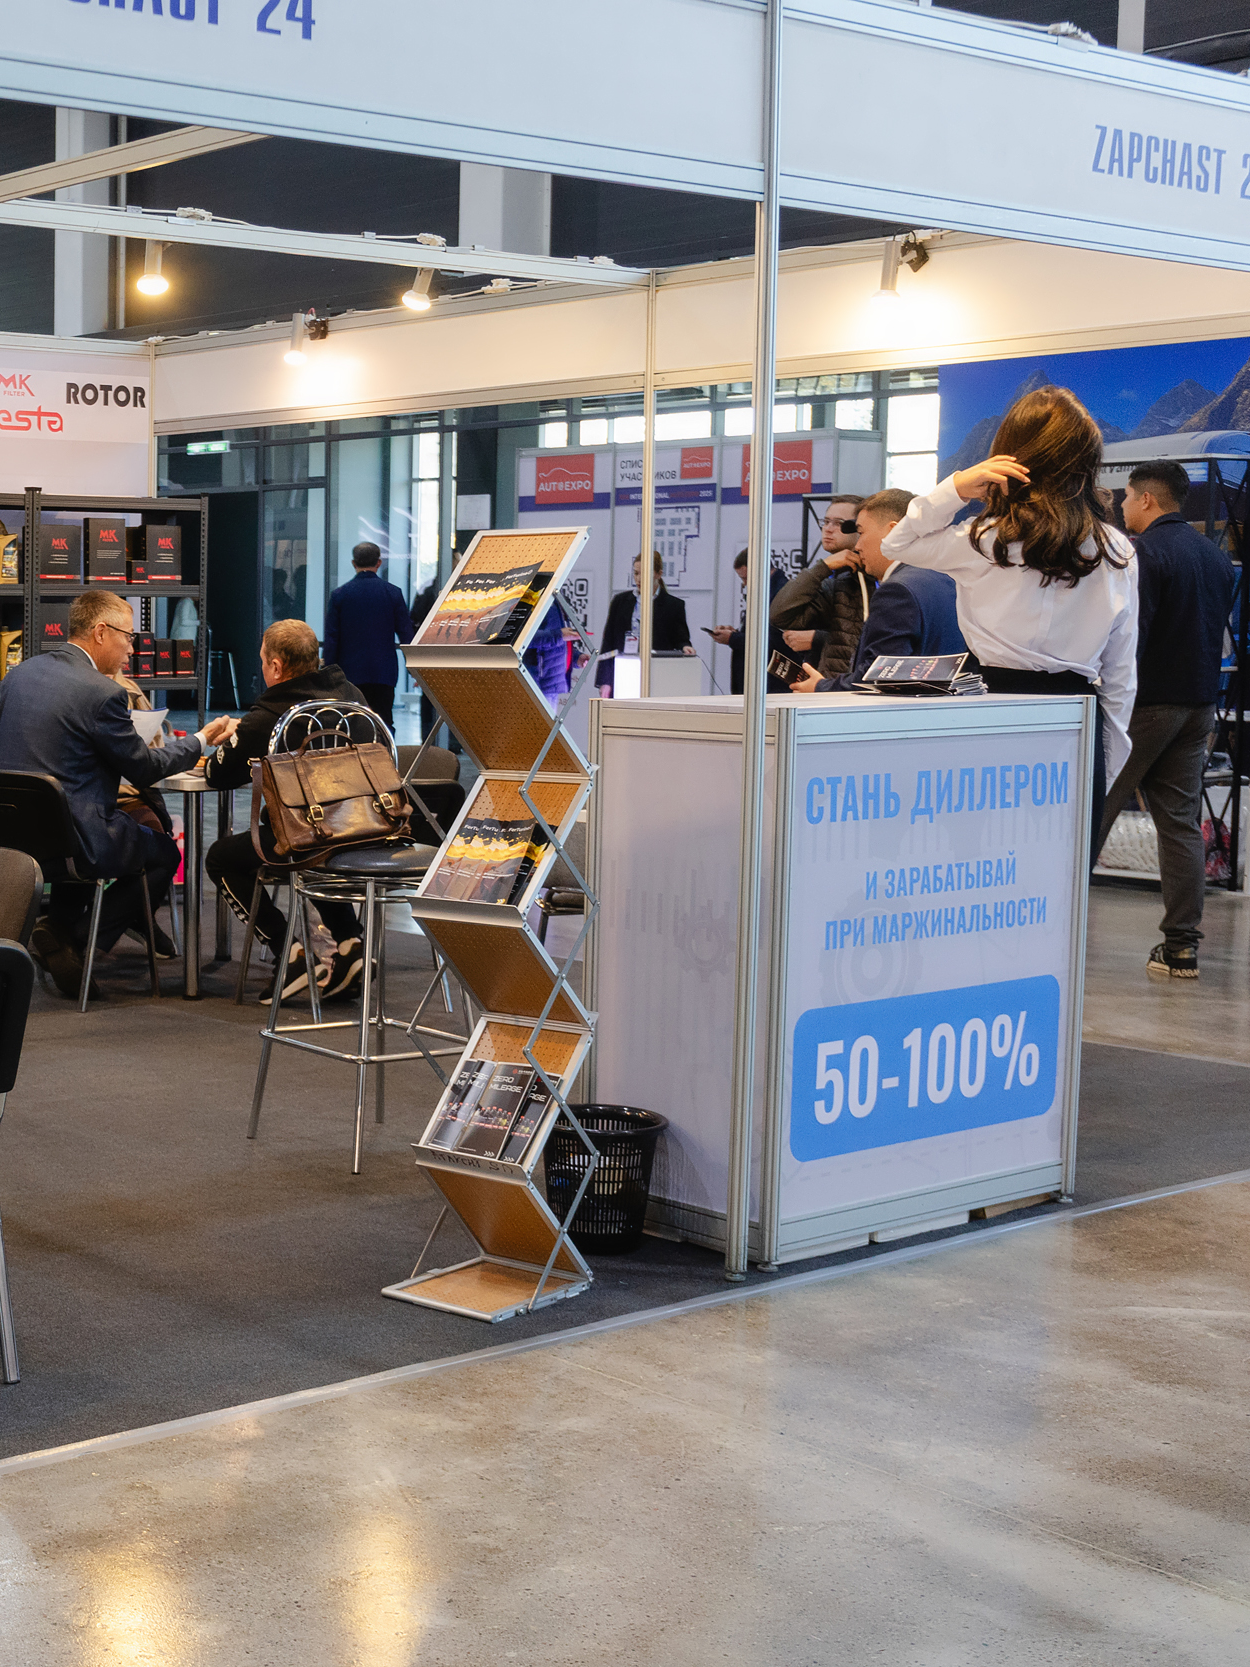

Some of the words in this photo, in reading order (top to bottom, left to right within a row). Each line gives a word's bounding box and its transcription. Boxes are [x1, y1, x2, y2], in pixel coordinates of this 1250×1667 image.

[1092, 124, 1226, 194] ZAPCHAST
[3, 390, 26, 398] FILTER
[65, 381, 147, 409] ROTOR
[620, 459, 644, 470] СПИС
[620, 469, 677, 482] УЧАСИКОВ
[744, 468, 809, 484] AEXPO
[99, 529, 119, 542] MK
[806, 771, 901, 826] СТАНЬ
[910, 761, 1069, 825] ДИЛЛЕРОМ
[865, 871, 878, 900] И
[884, 850, 1016, 899] ЗАРАБАТЫВАЙ
[824, 918, 865, 951] ПРИ
[872, 896, 1047, 945] МАРЖИНАЛЬНОСТИ
[493, 1074, 515, 1083] ZERO
[814, 1010, 1040, 1125] 50-100%
